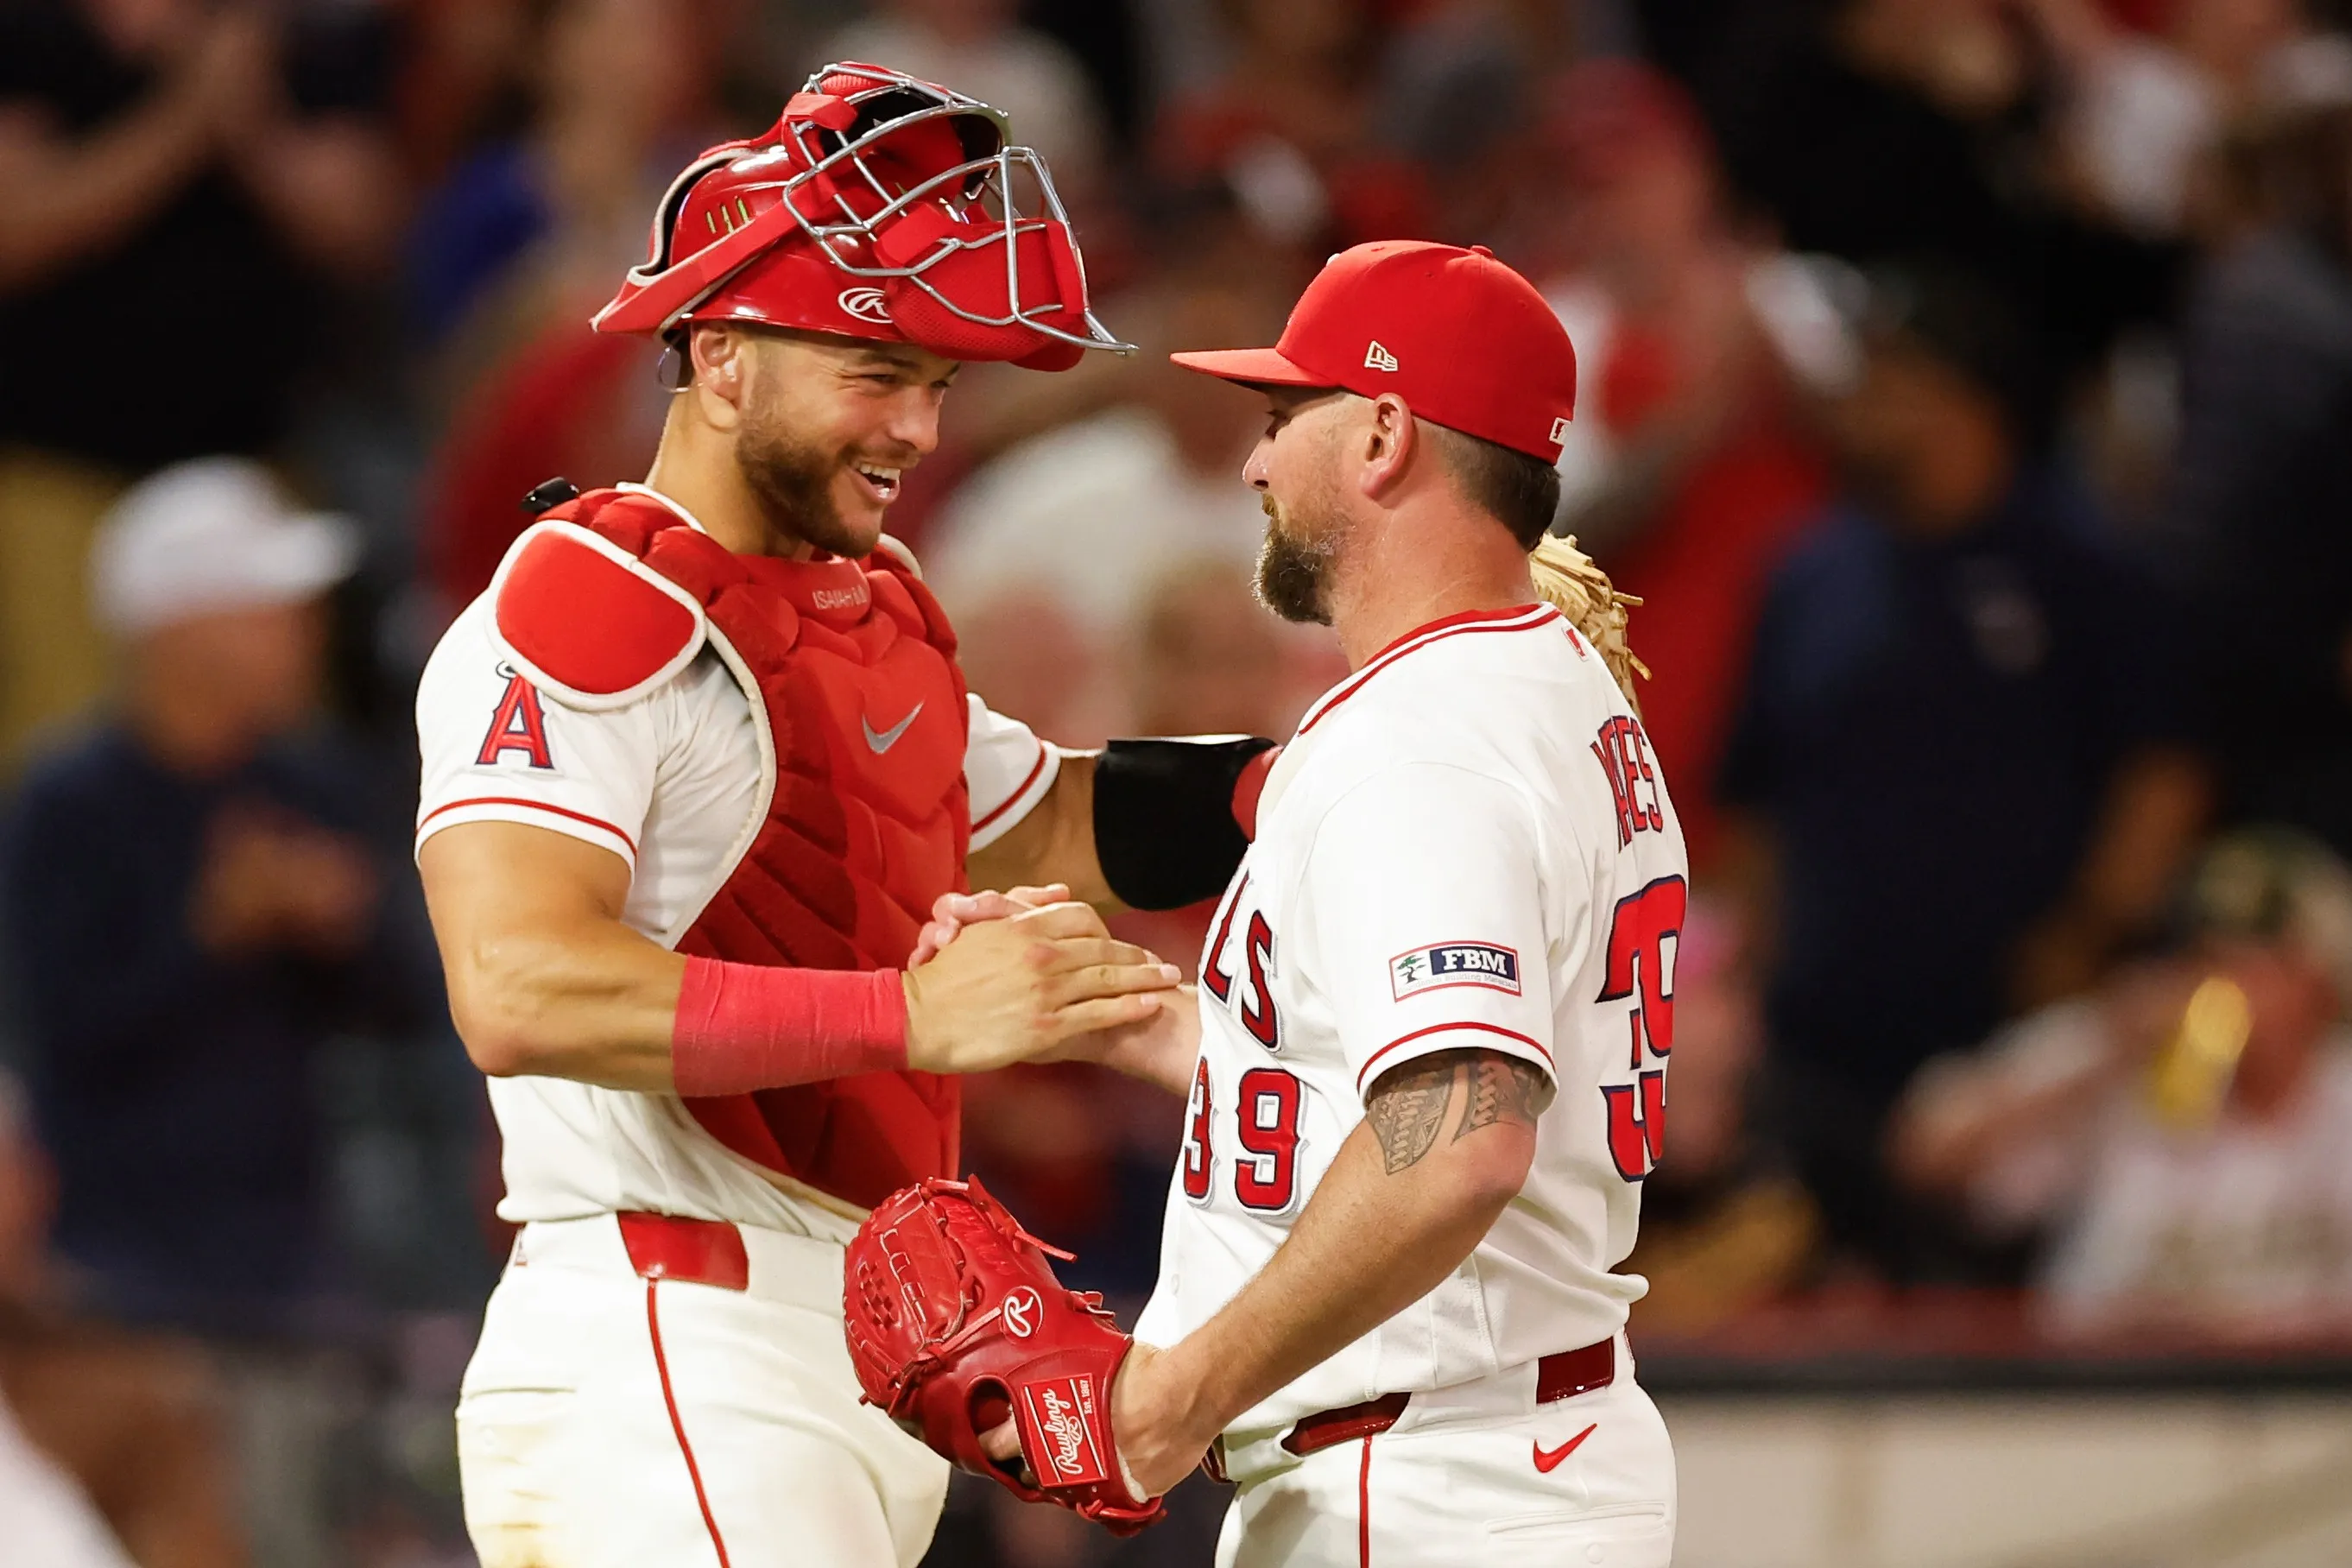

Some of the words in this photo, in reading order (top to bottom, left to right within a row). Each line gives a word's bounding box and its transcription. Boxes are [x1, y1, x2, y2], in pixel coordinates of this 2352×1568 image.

[1442, 949, 1508, 974] FBM
[1184, 1055, 1300, 1211] 39
[1042, 1388, 1084, 1475] Rawlings
